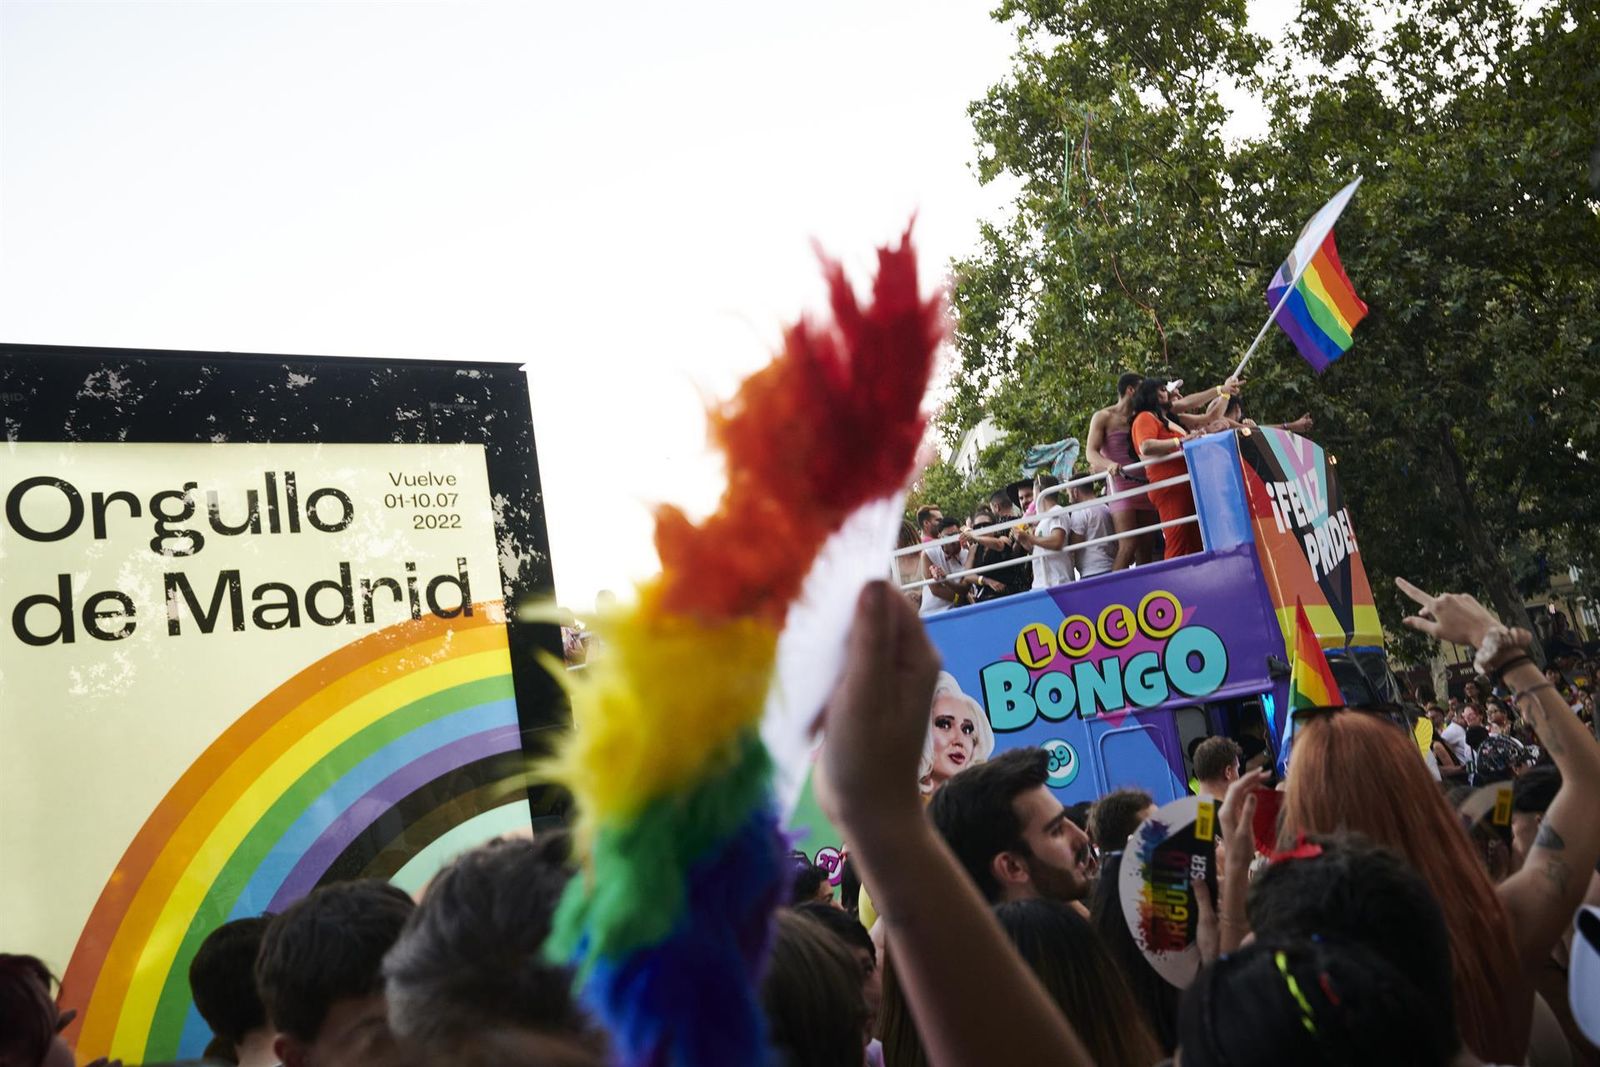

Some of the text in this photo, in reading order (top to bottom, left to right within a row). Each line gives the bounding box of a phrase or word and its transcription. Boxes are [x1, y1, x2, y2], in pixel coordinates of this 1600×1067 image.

[384, 492, 459, 509] 01-10.07
[389, 471, 457, 487] Vuelve
[5, 471, 354, 557] Orgullo
[413, 514, 462, 530] 2022
[12, 556, 474, 647] de Madrid
[1017, 592, 1180, 668] LOCO
[980, 625, 1228, 732] BONGO
[1190, 854, 1207, 880] SER
